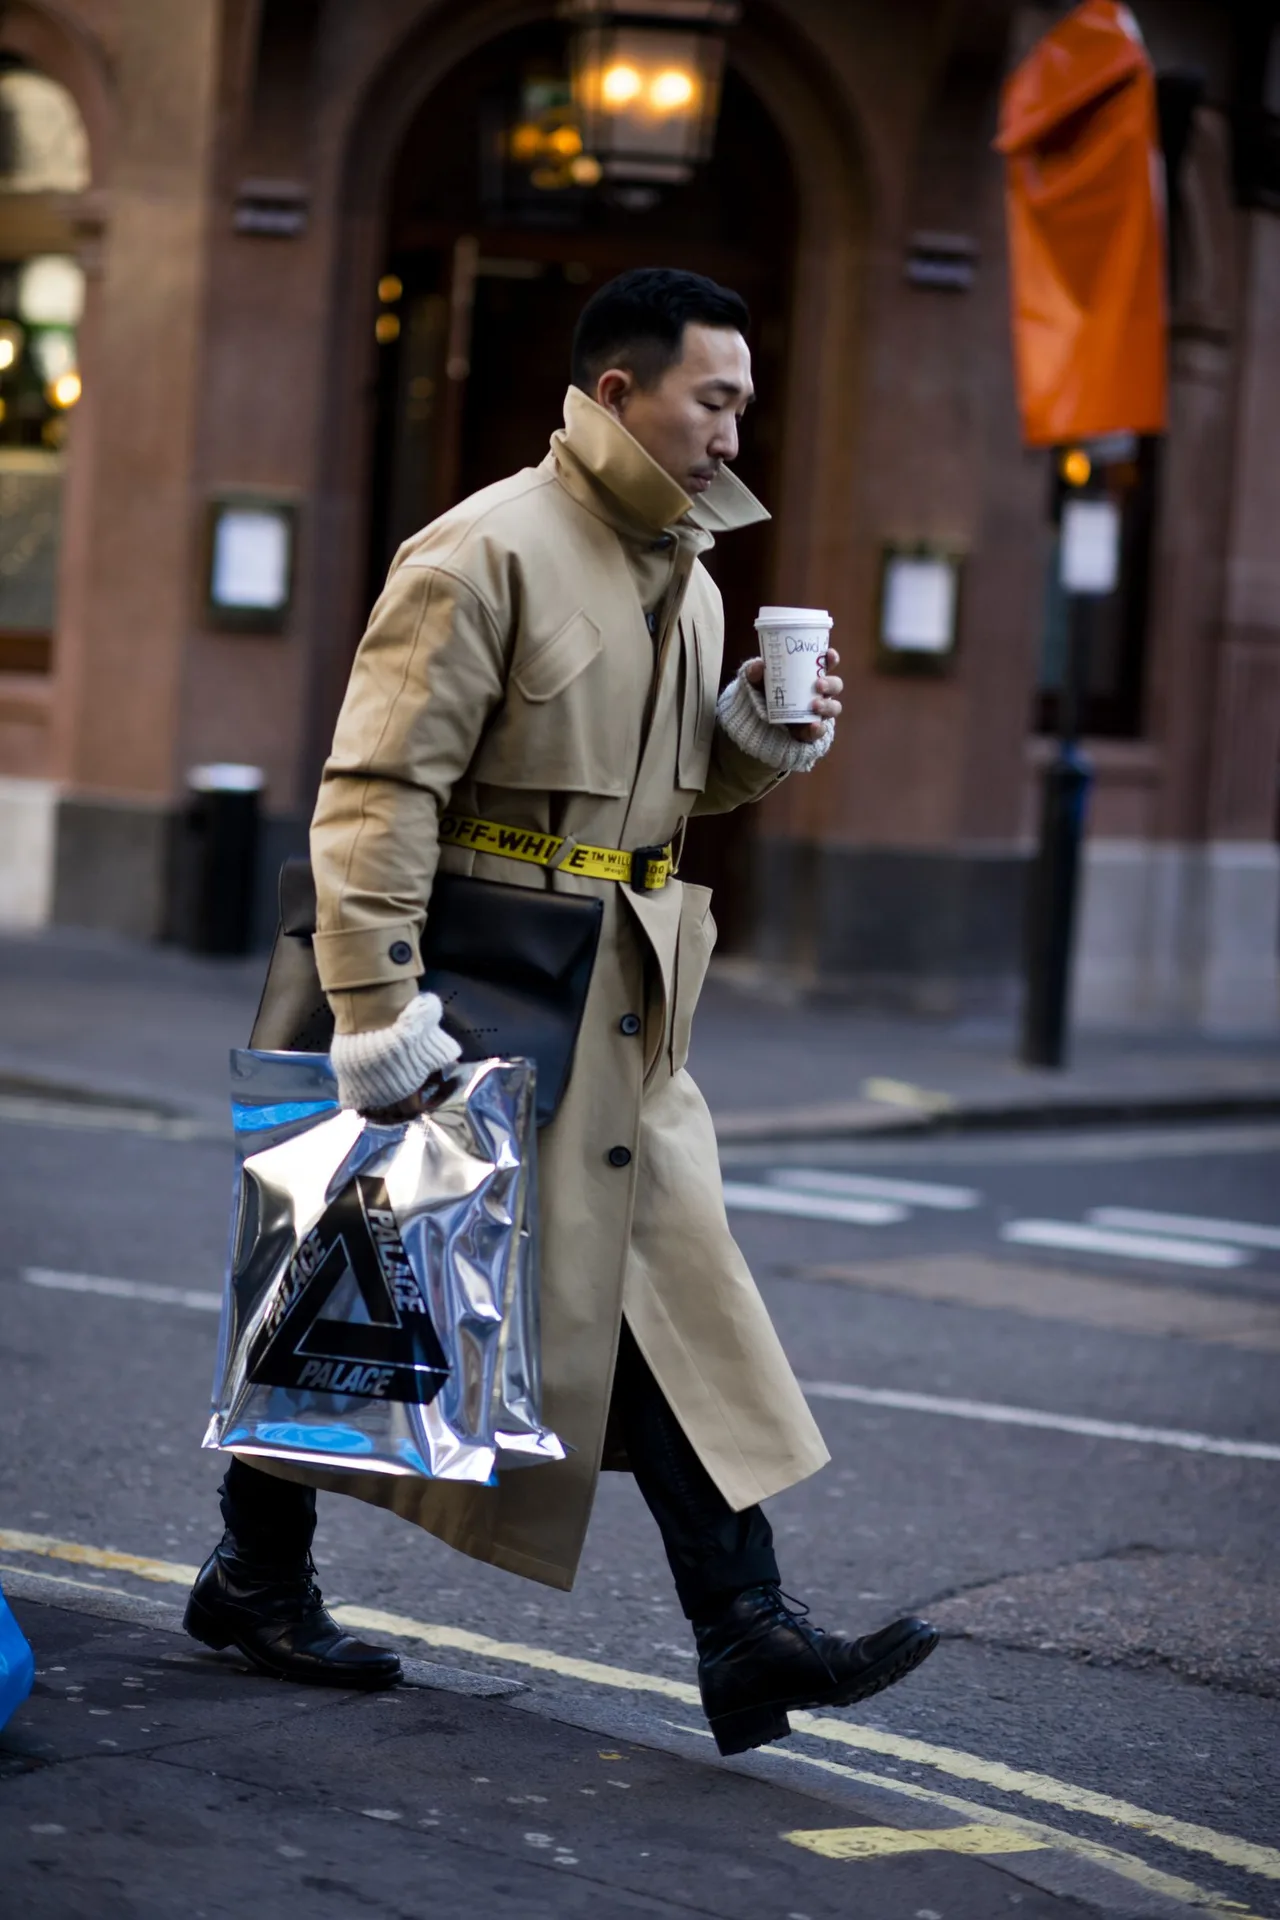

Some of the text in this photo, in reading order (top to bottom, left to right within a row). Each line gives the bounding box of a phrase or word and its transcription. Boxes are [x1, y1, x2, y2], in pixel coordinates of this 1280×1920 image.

[785, 635, 820, 655] David
[439, 817, 589, 869] OFF-WHIE
[264, 1225, 327, 1338] PALACE
[366, 1207, 427, 1315] PALACE
[296, 1359, 395, 1397] PALACE
